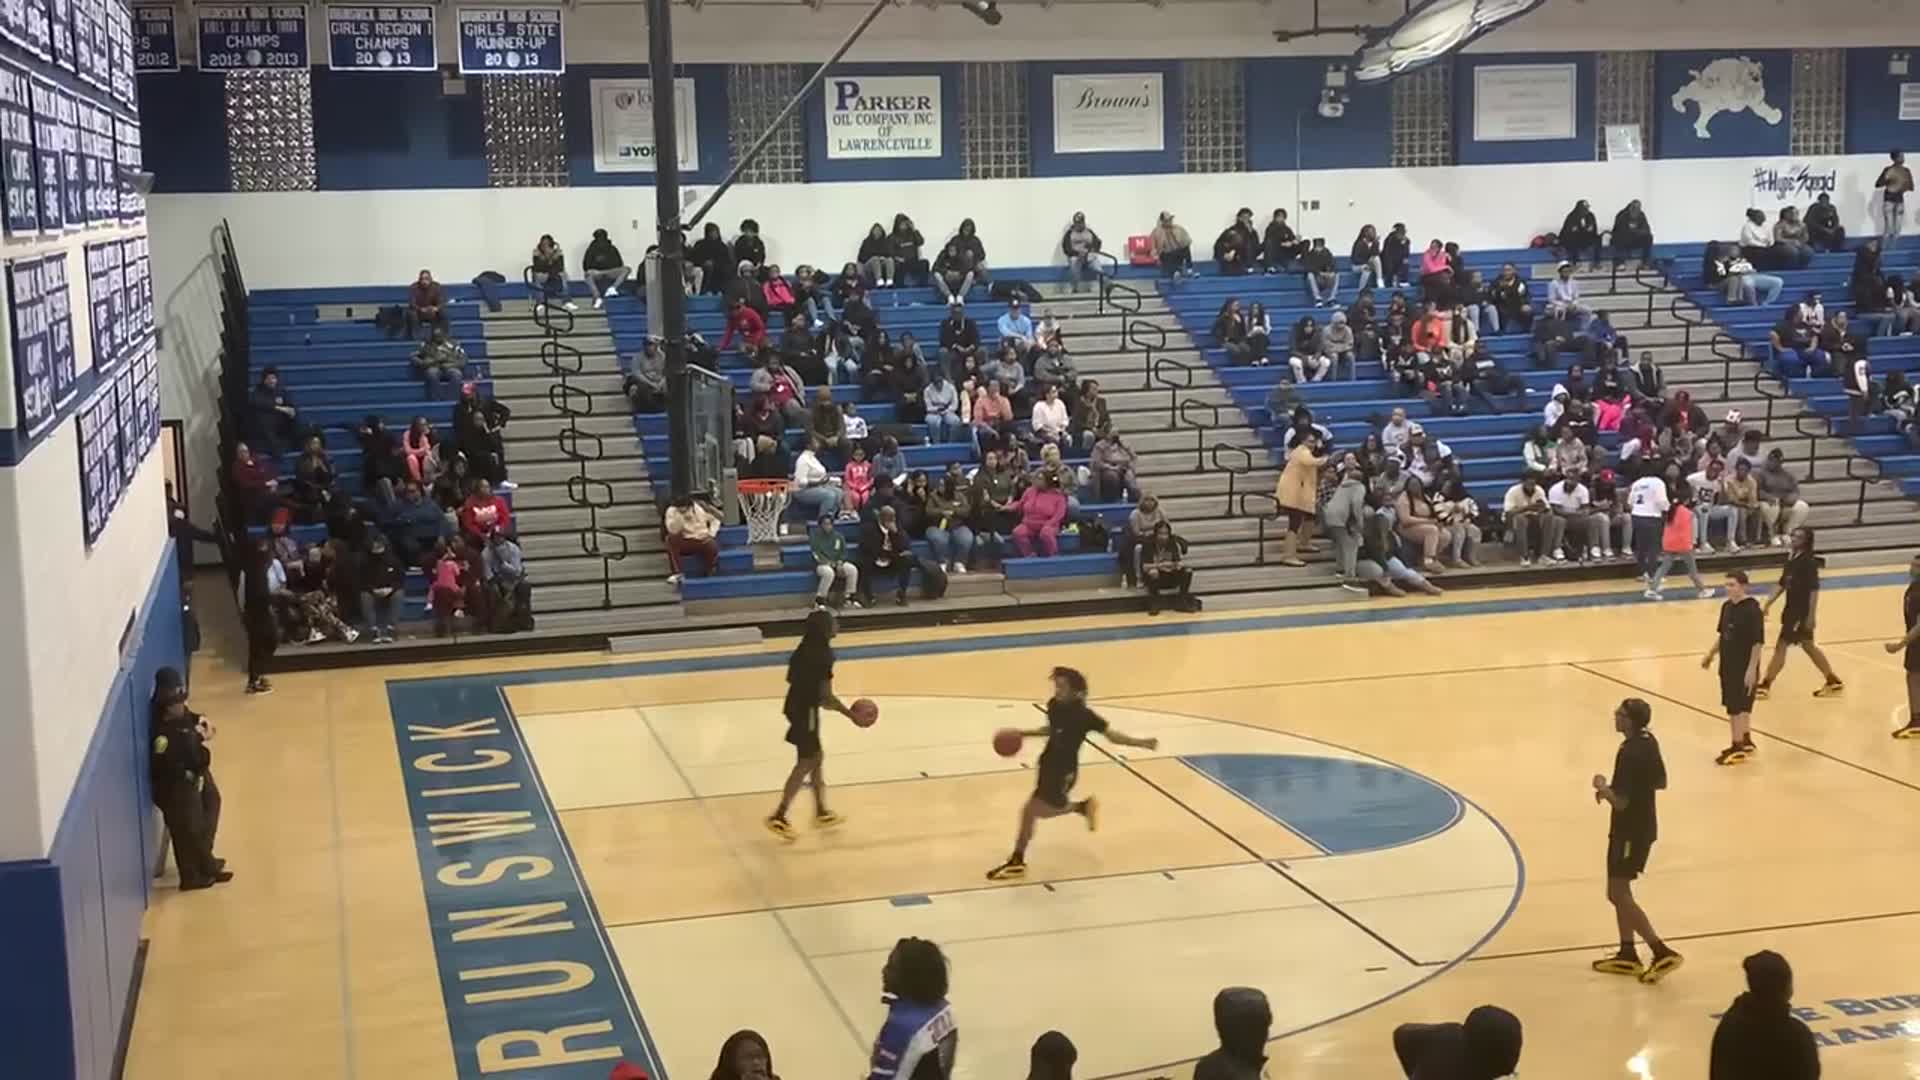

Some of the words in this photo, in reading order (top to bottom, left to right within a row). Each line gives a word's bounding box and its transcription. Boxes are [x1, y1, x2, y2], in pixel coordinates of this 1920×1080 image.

[331, 22, 369, 35] GIRLS
[375, 22, 421, 35] REGION
[464, 24, 505, 37] GIRLS
[516, 24, 556, 36] STATE
[225, 35, 280, 49] CHAMPS
[355, 37, 410, 49] CHAMPS
[475, 37, 546, 49] RUNNER-UP
[137, 53, 169, 66] 2012
[209, 53, 242, 66] 2012
[266, 53, 299, 66] 2013
[355, 51, 373, 65] 20
[397, 52, 411, 65] 13
[485, 53, 502, 66] 20
[524, 53, 539, 66] 13
[834, 81, 931, 111] PARKER
[832, 114, 852, 126] OIL
[878, 126, 892, 137] OF
[839, 138, 933, 152] LAWRENCEVILLE
